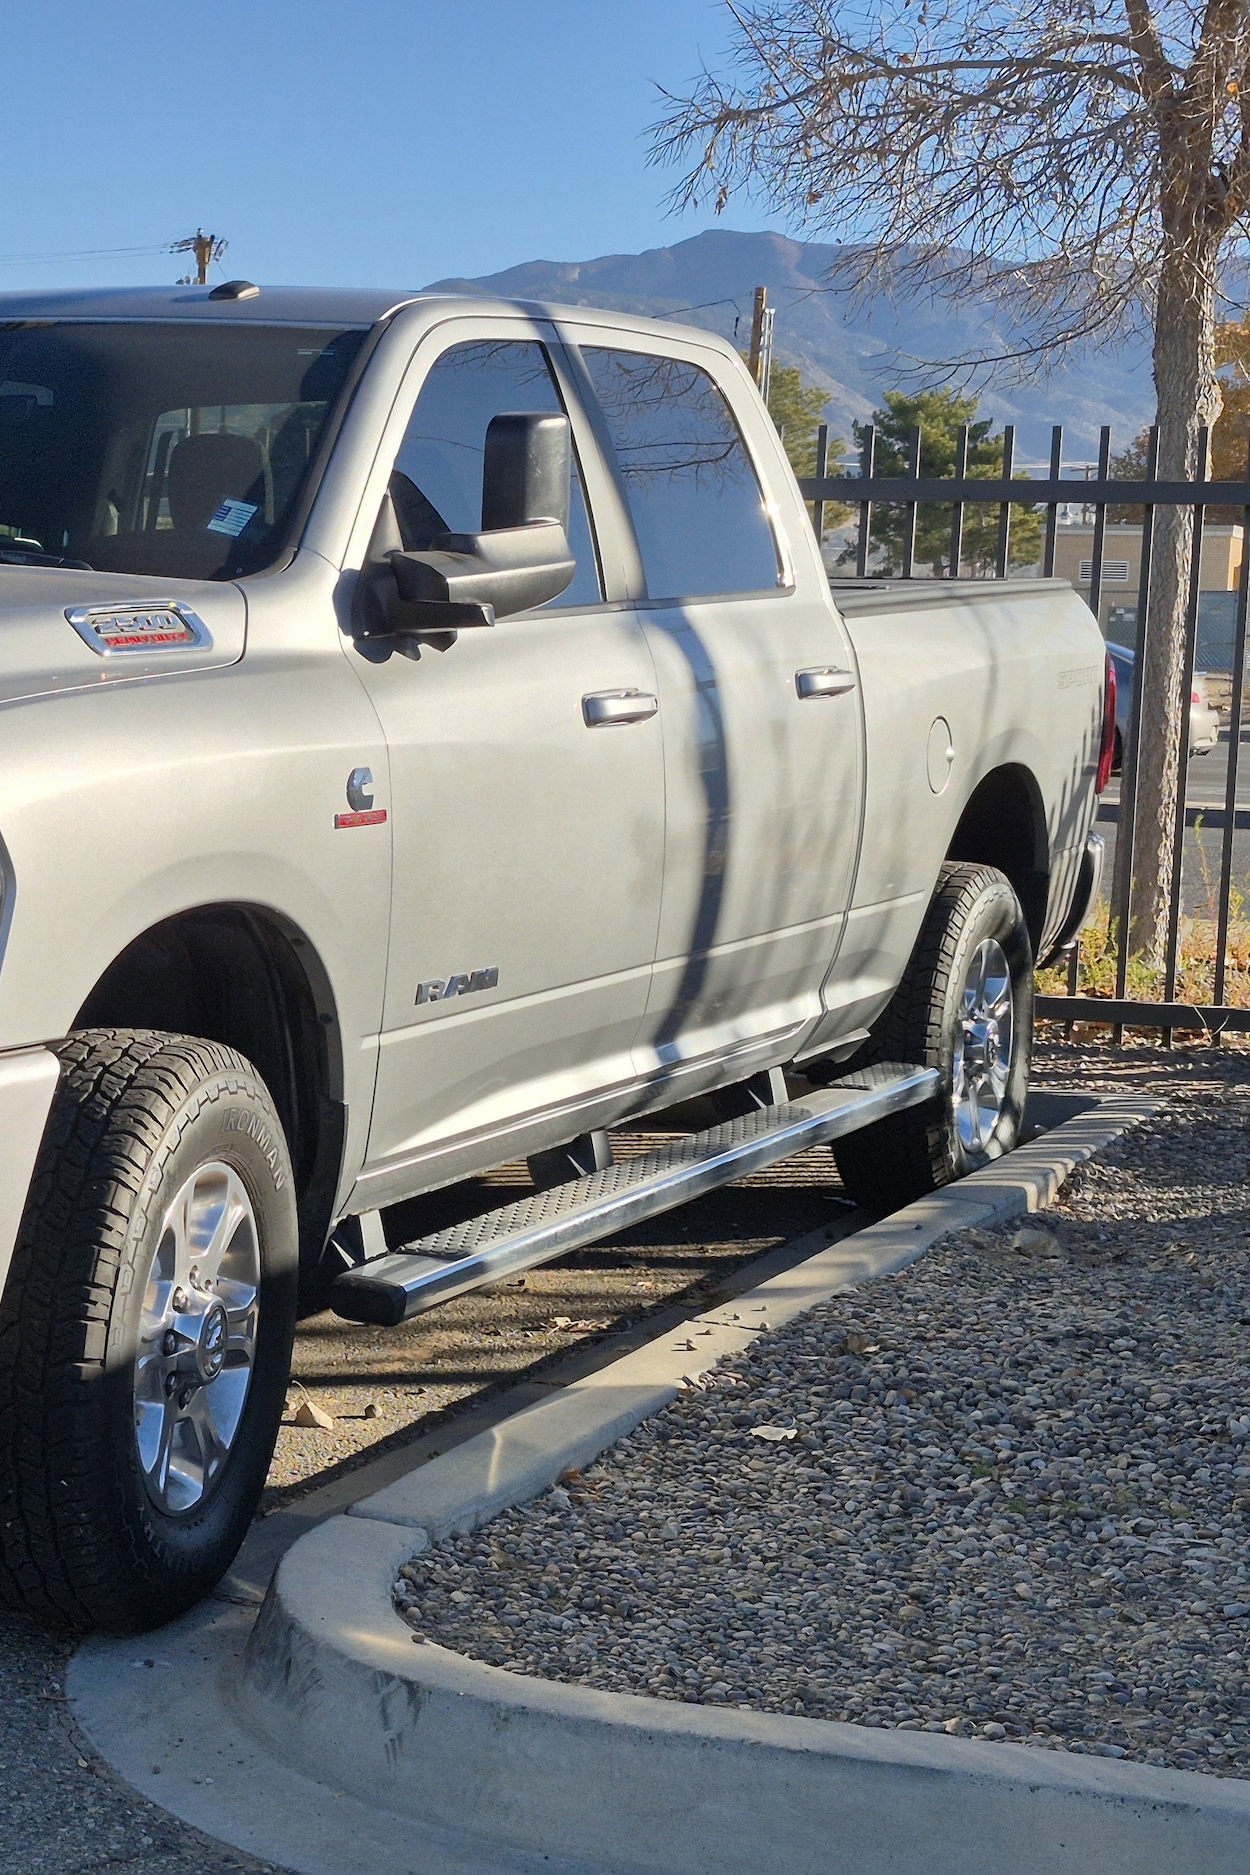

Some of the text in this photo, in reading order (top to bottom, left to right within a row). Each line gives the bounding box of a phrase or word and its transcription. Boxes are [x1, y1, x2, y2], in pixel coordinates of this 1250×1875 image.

[92, 614, 179, 634] 2500
[1057, 665, 1099, 690] SPORT
[414, 966, 499, 1005] RAM
[220, 1107, 287, 1192] IRONMAN
